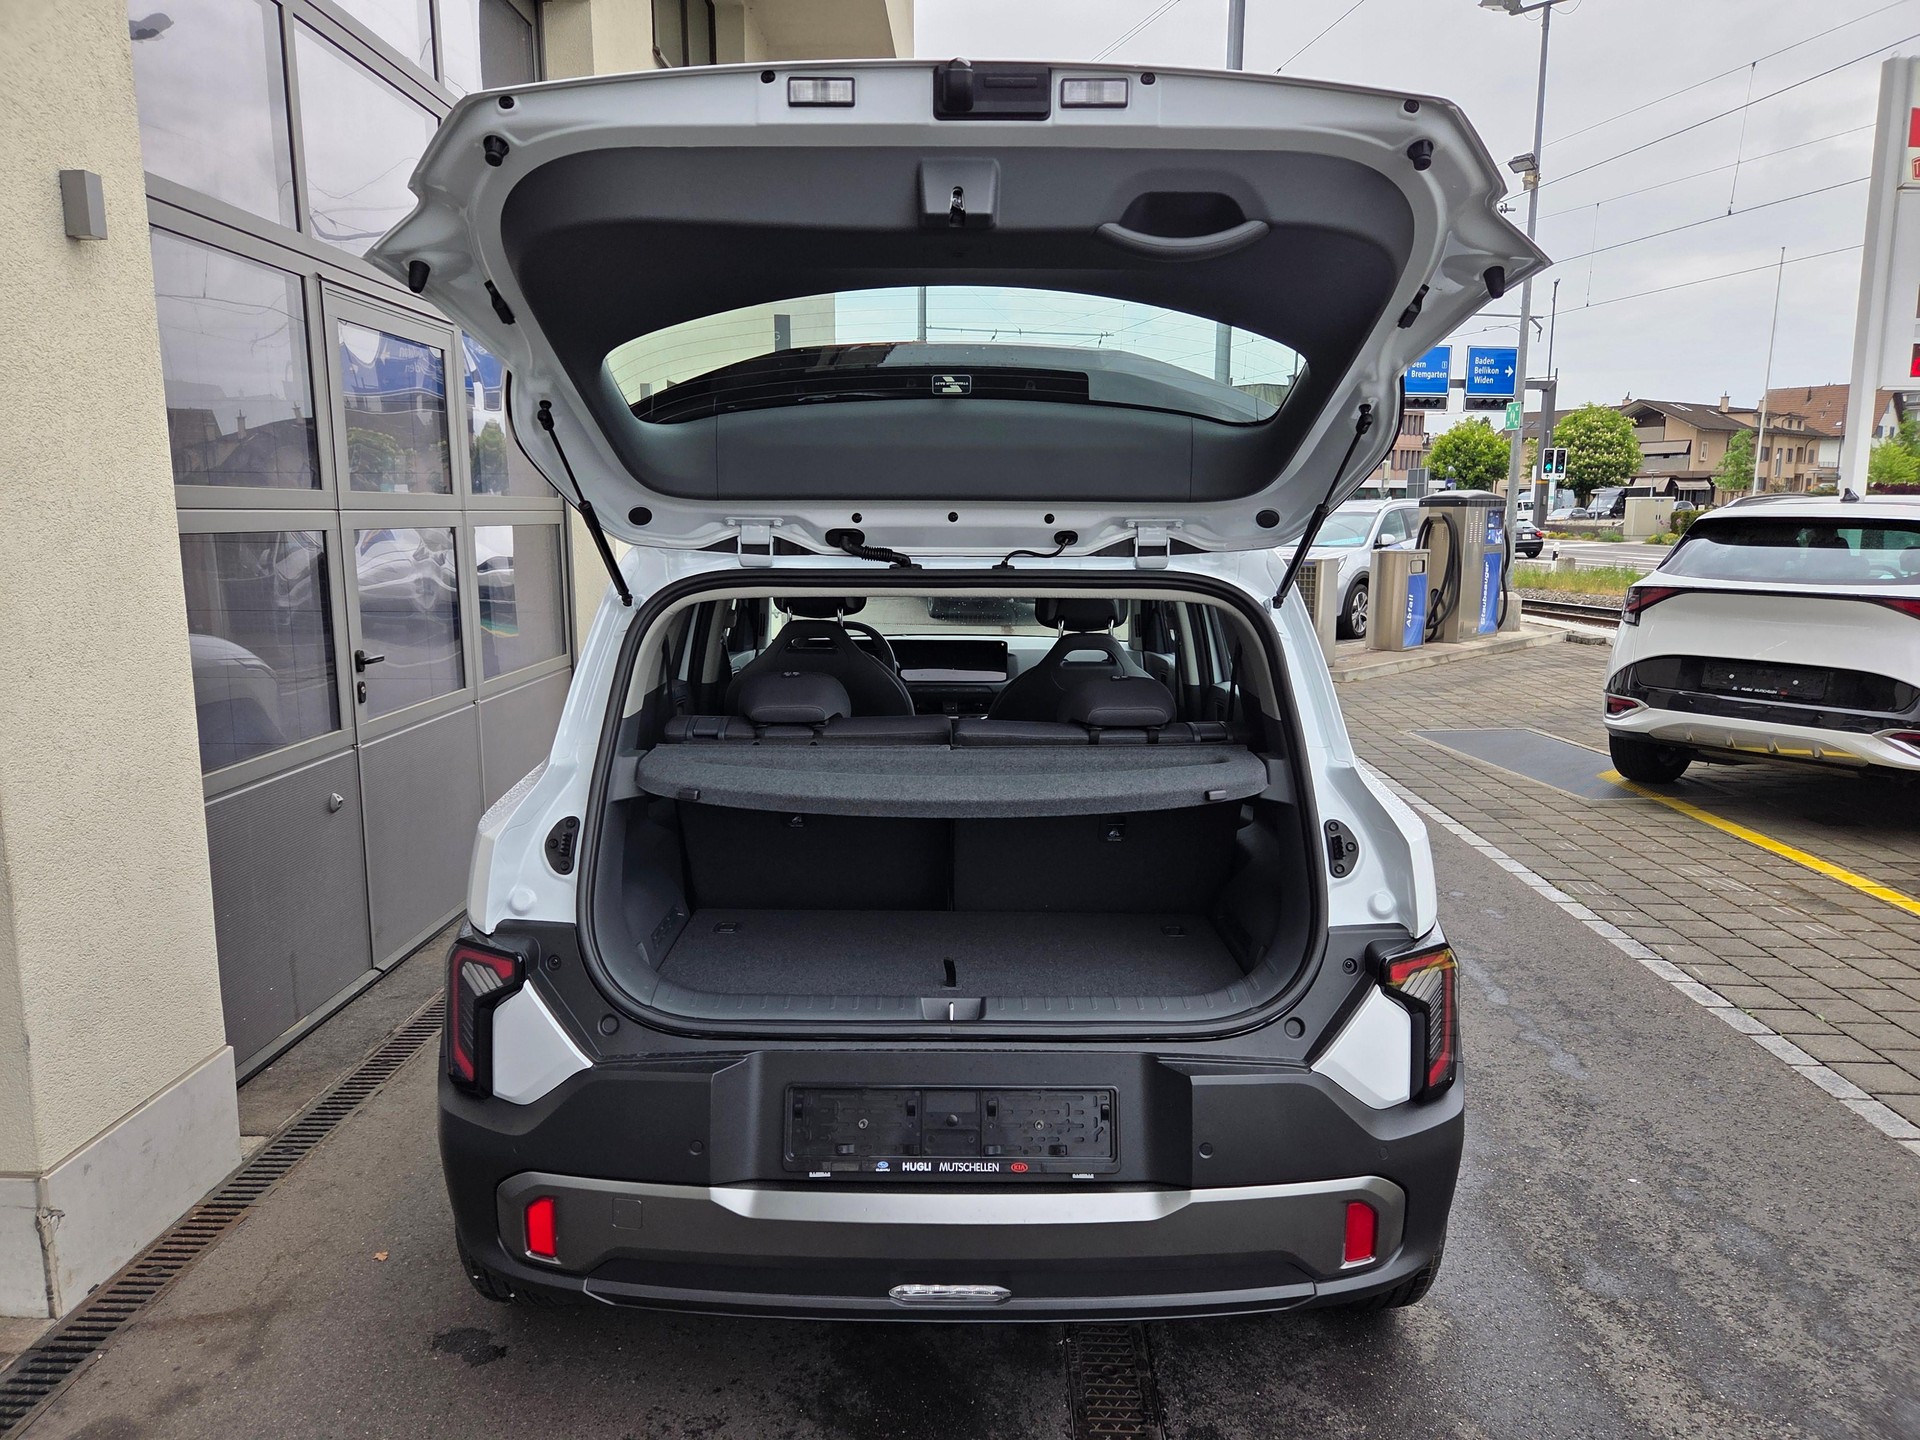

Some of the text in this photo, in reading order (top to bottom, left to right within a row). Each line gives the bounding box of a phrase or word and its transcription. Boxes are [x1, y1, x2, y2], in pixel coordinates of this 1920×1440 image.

[1474, 356, 1495, 365] Baden
[1411, 370, 1447, 379] Bremgarten
[1474, 366, 1500, 375] Bellikon
[1473, 376, 1494, 384] Widen
[1480, 561, 1489, 625] Staubsauger
[902, 1162, 932, 1172] HUGLI
[938, 1162, 1000, 1172] MUTSCHELLEN
